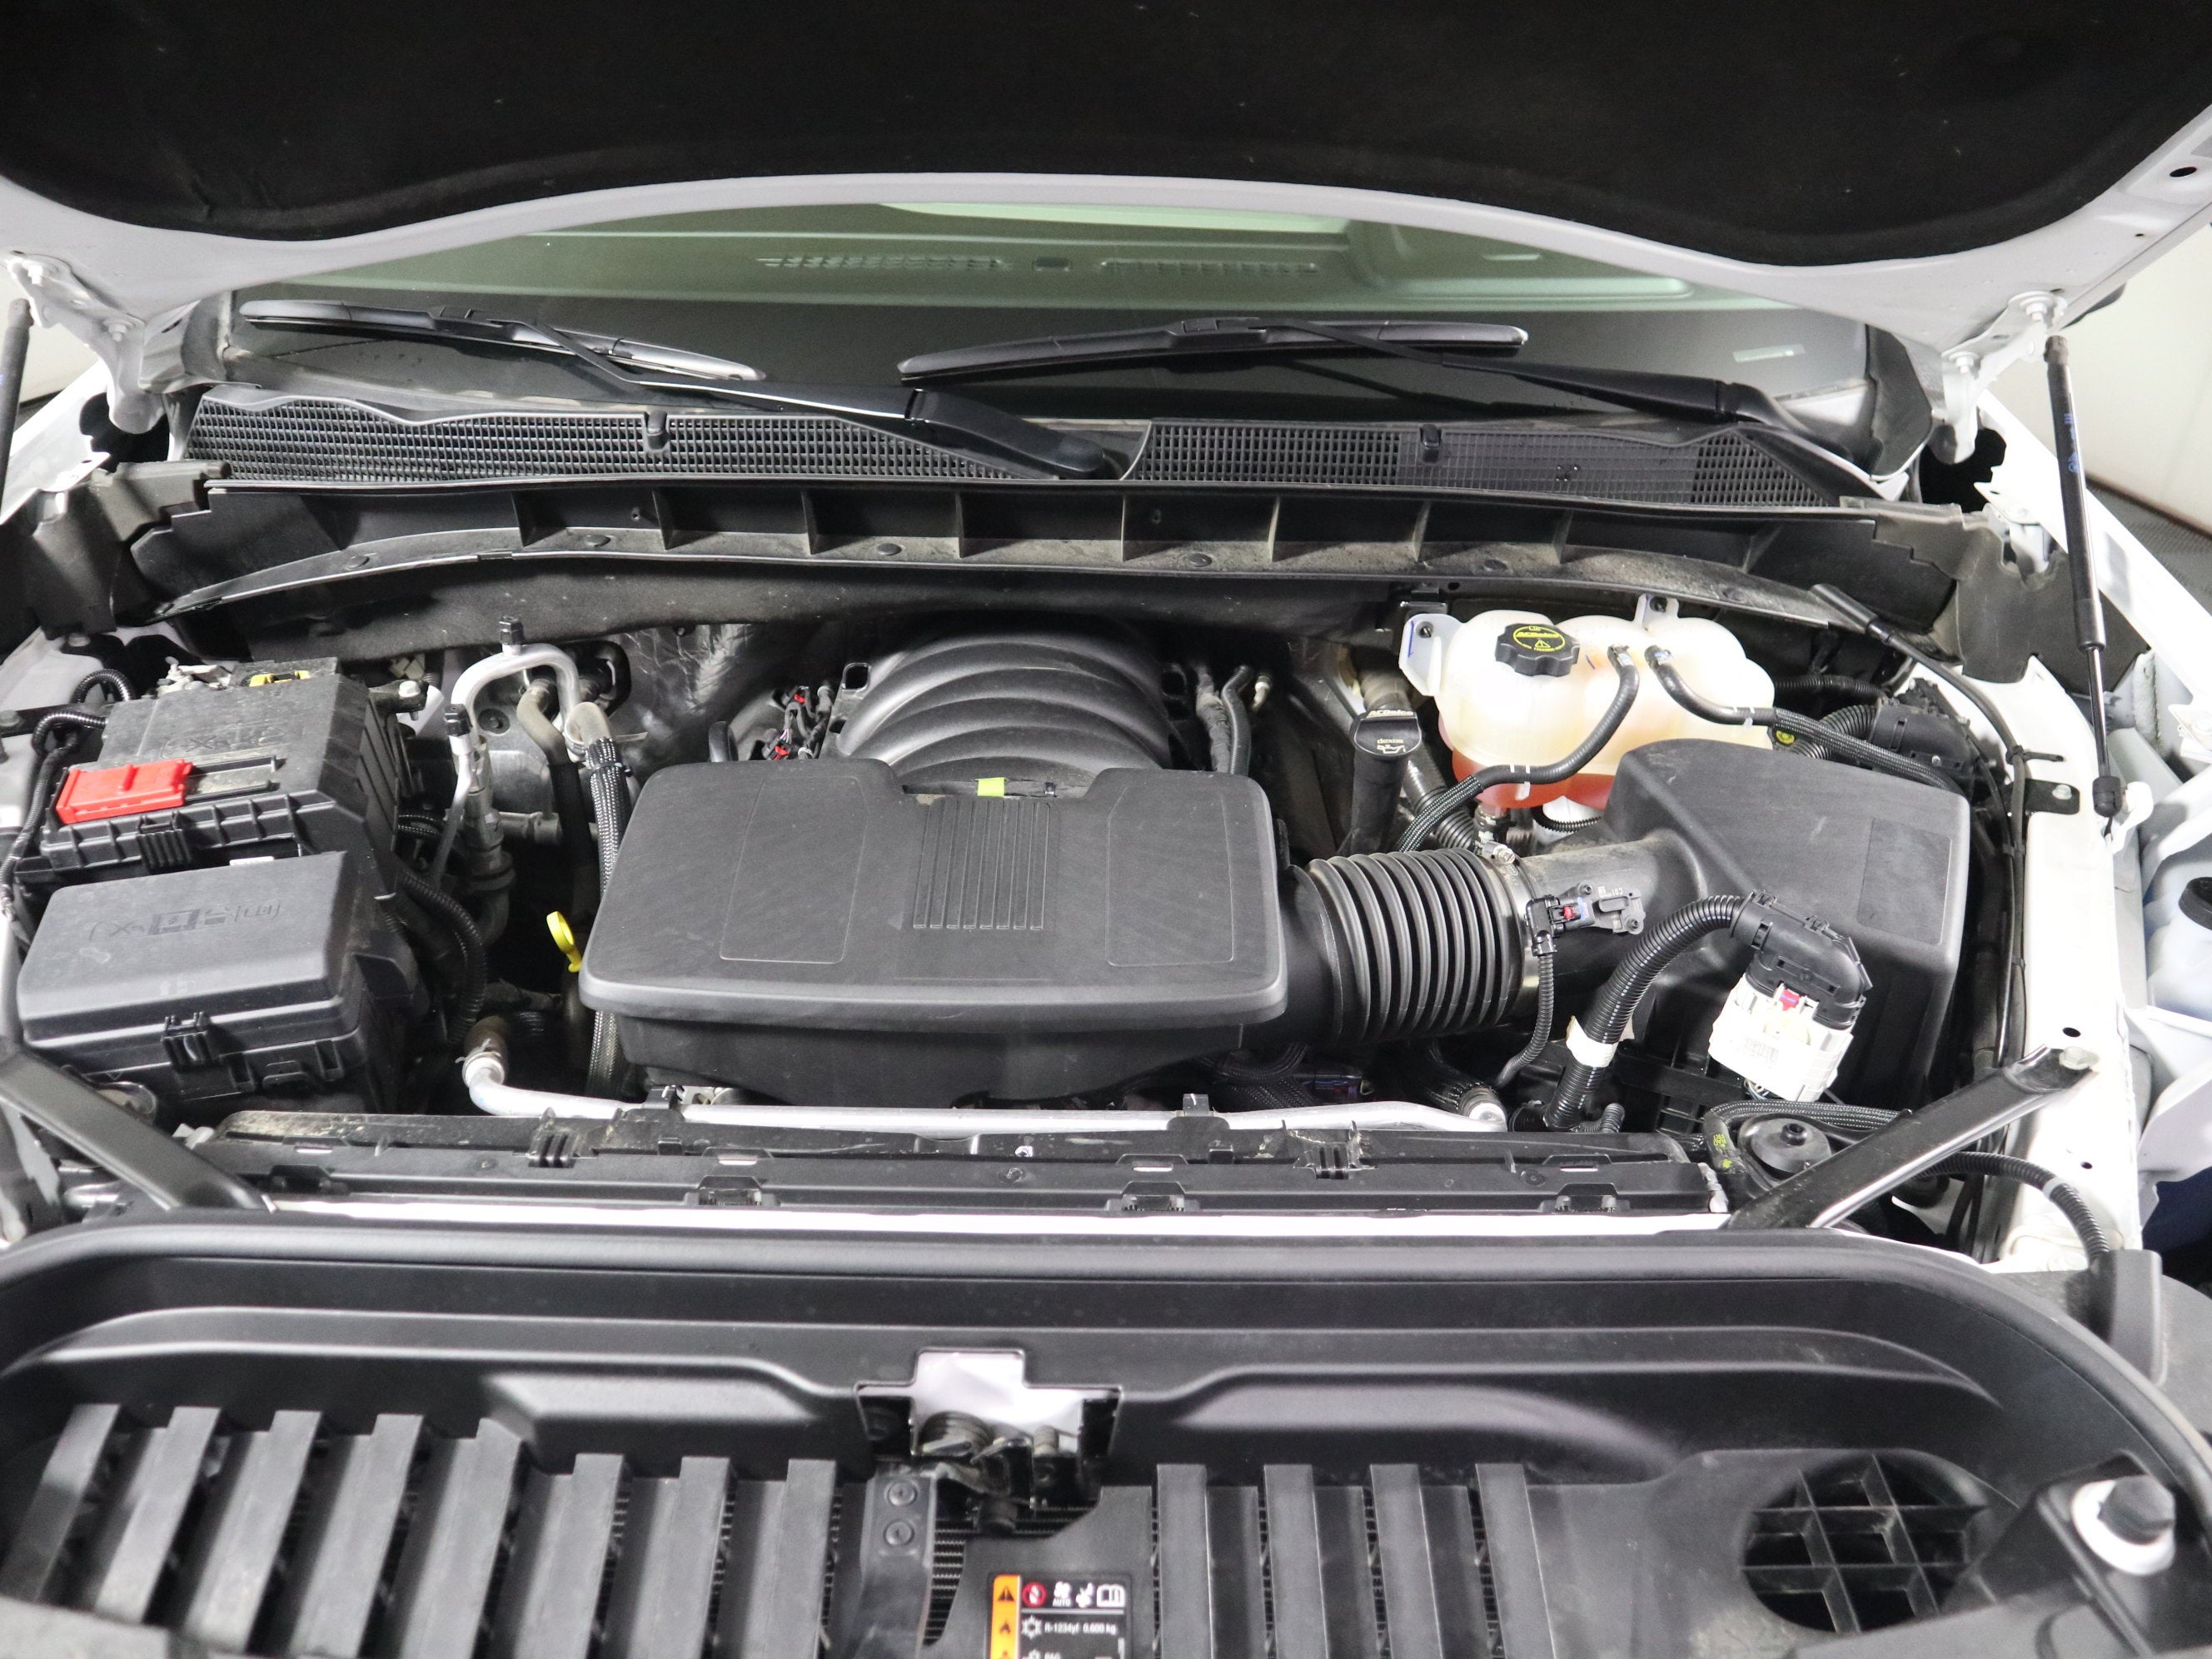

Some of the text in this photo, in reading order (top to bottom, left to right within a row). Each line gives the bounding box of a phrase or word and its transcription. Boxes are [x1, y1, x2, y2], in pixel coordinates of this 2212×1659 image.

[1053, 1598, 1071, 1607] AUTO
[1044, 1622, 1079, 1635] R-1234yf
[1105, 1622, 1117, 1635] kg
